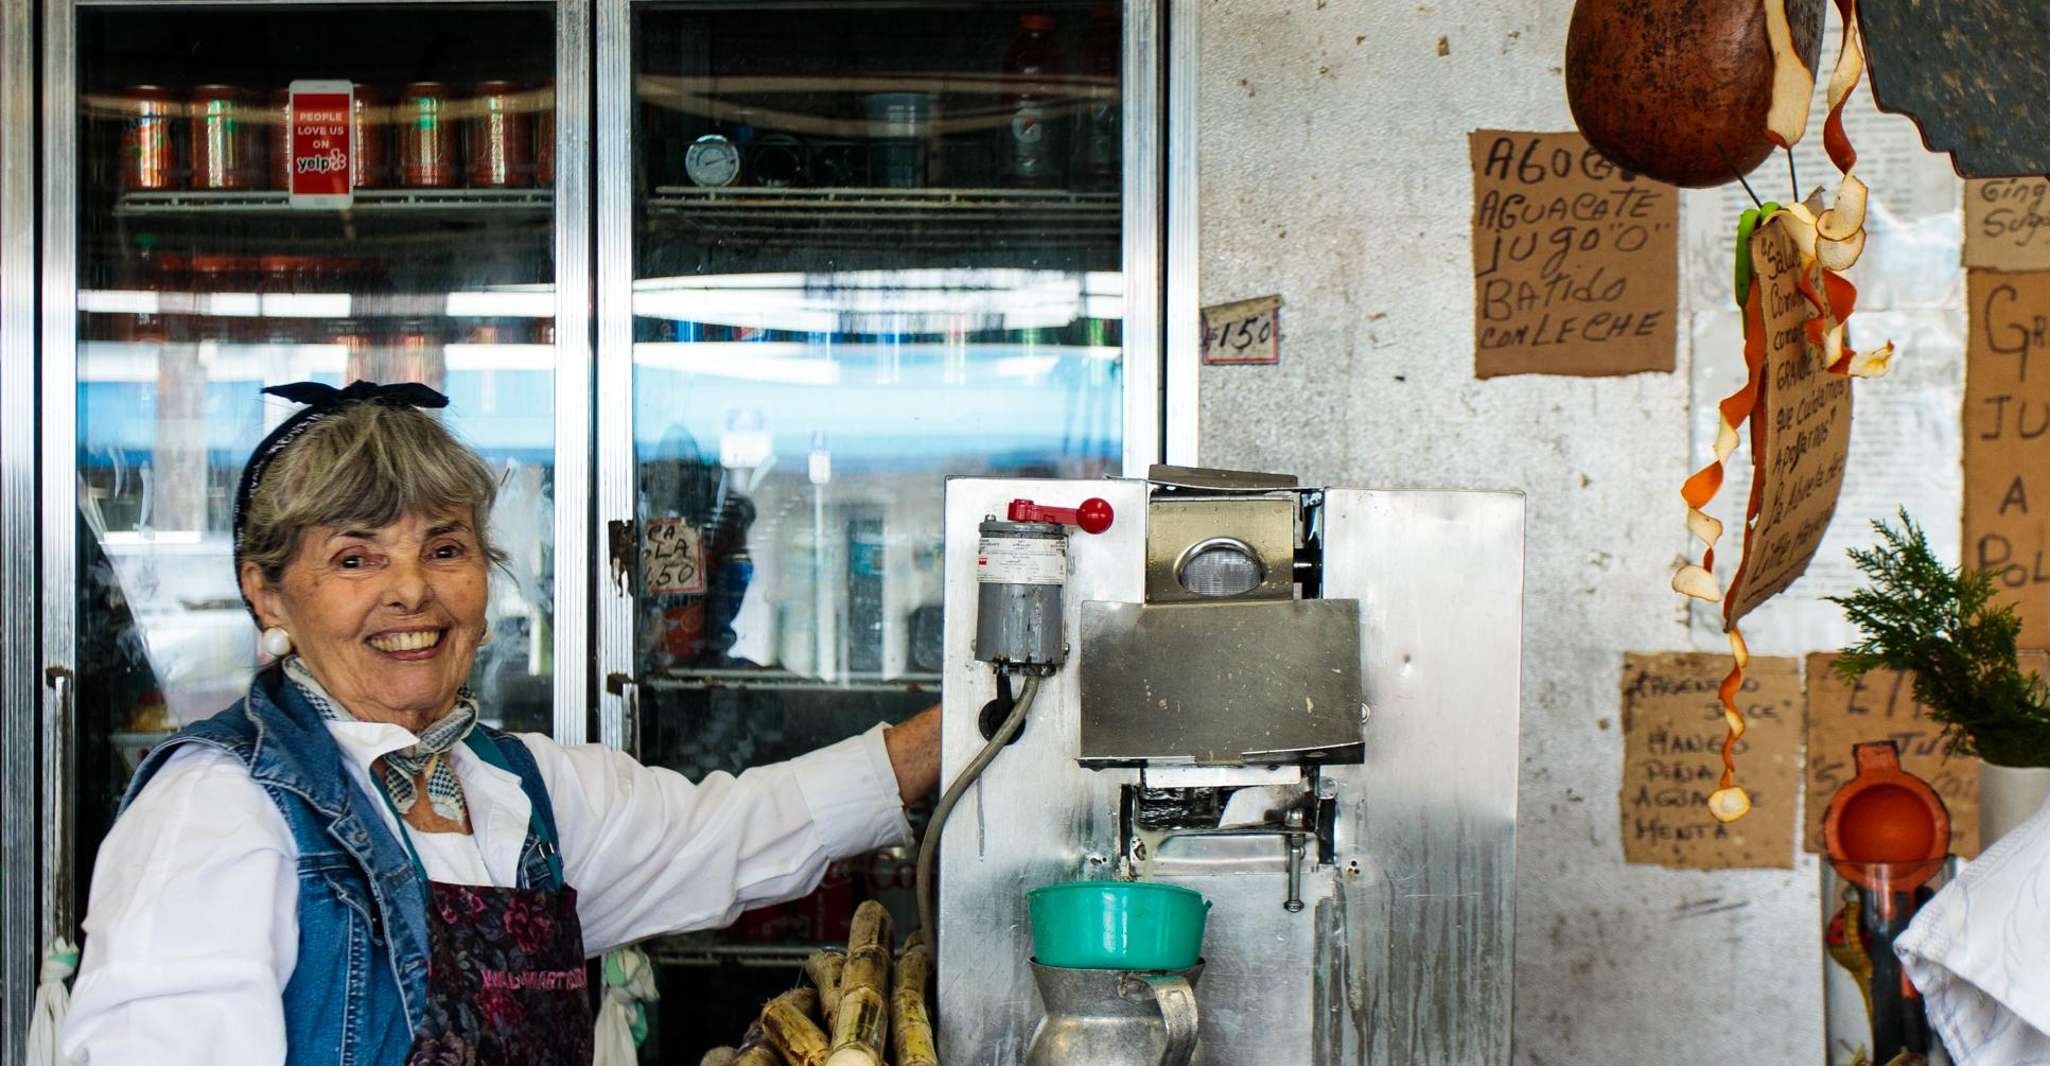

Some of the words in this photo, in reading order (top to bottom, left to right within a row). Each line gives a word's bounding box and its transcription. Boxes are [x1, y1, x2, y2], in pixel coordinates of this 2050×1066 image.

[299, 112, 343, 122] PEOPLE
[297, 127, 327, 136] LOVE
[329, 127, 344, 136] US
[312, 141, 330, 149] ON
[297, 155, 332, 174] yelp
[1477, 187, 1663, 230] AGUACATE
[1998, 475, 2029, 515] A
